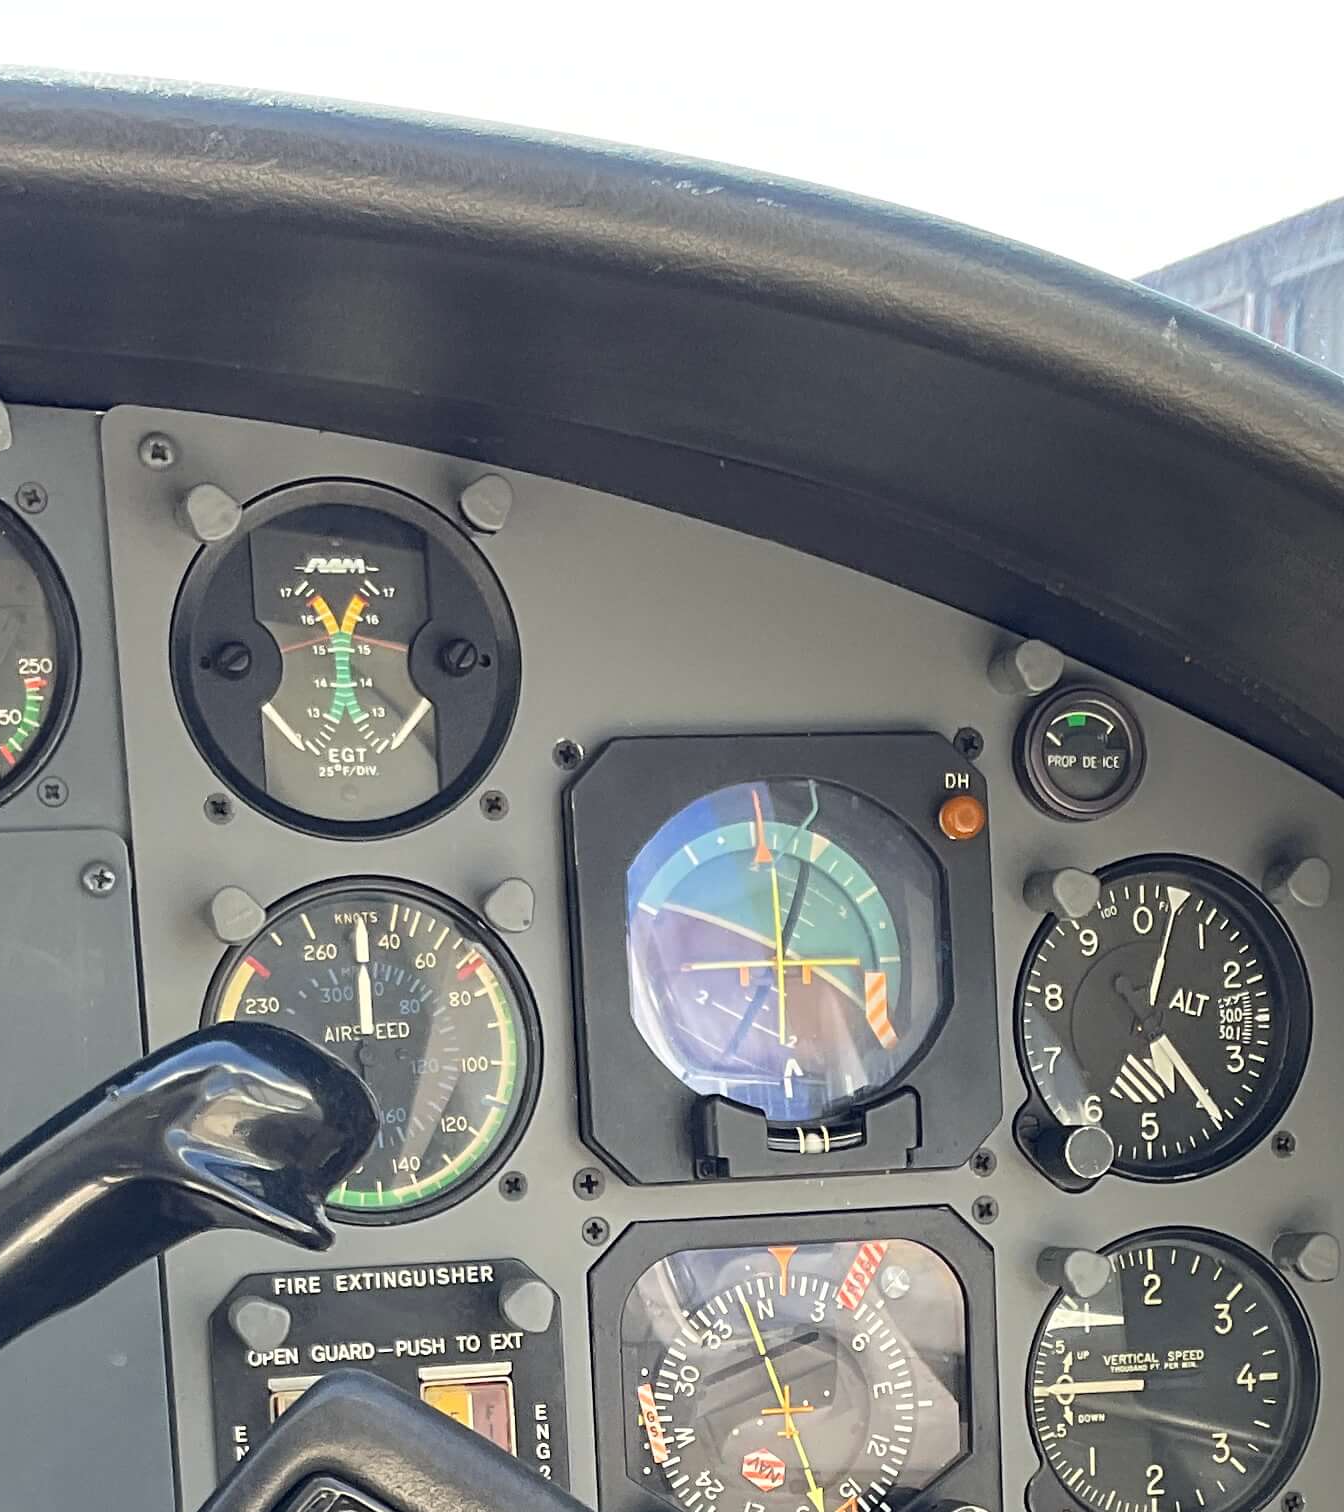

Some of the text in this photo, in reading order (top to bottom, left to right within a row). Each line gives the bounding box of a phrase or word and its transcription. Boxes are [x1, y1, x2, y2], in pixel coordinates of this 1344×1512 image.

[328, 749, 367, 762] EGT
[1047, 755, 1076, 767] PROP
[945, 773, 969, 790] DH
[378, 935, 400, 950] 40
[415, 953, 436, 969] 60
[245, 998, 280, 1014] 230
[449, 992, 471, 1007] 80
[1169, 988, 1209, 1016] ALT
[461, 1057, 488, 1073] 100
[441, 1116, 467, 1132] 120
[392, 1157, 420, 1173] 140
[274, 1265, 494, 1295] FIRE EXTINGUISHER
[248, 1332, 524, 1368] OPEN TO EXT
[1077, 1351, 1090, 1359] UP
[1103, 1349, 1204, 1366] VERTICAL SPEED
[1078, 1413, 1105, 1424] DOWN
